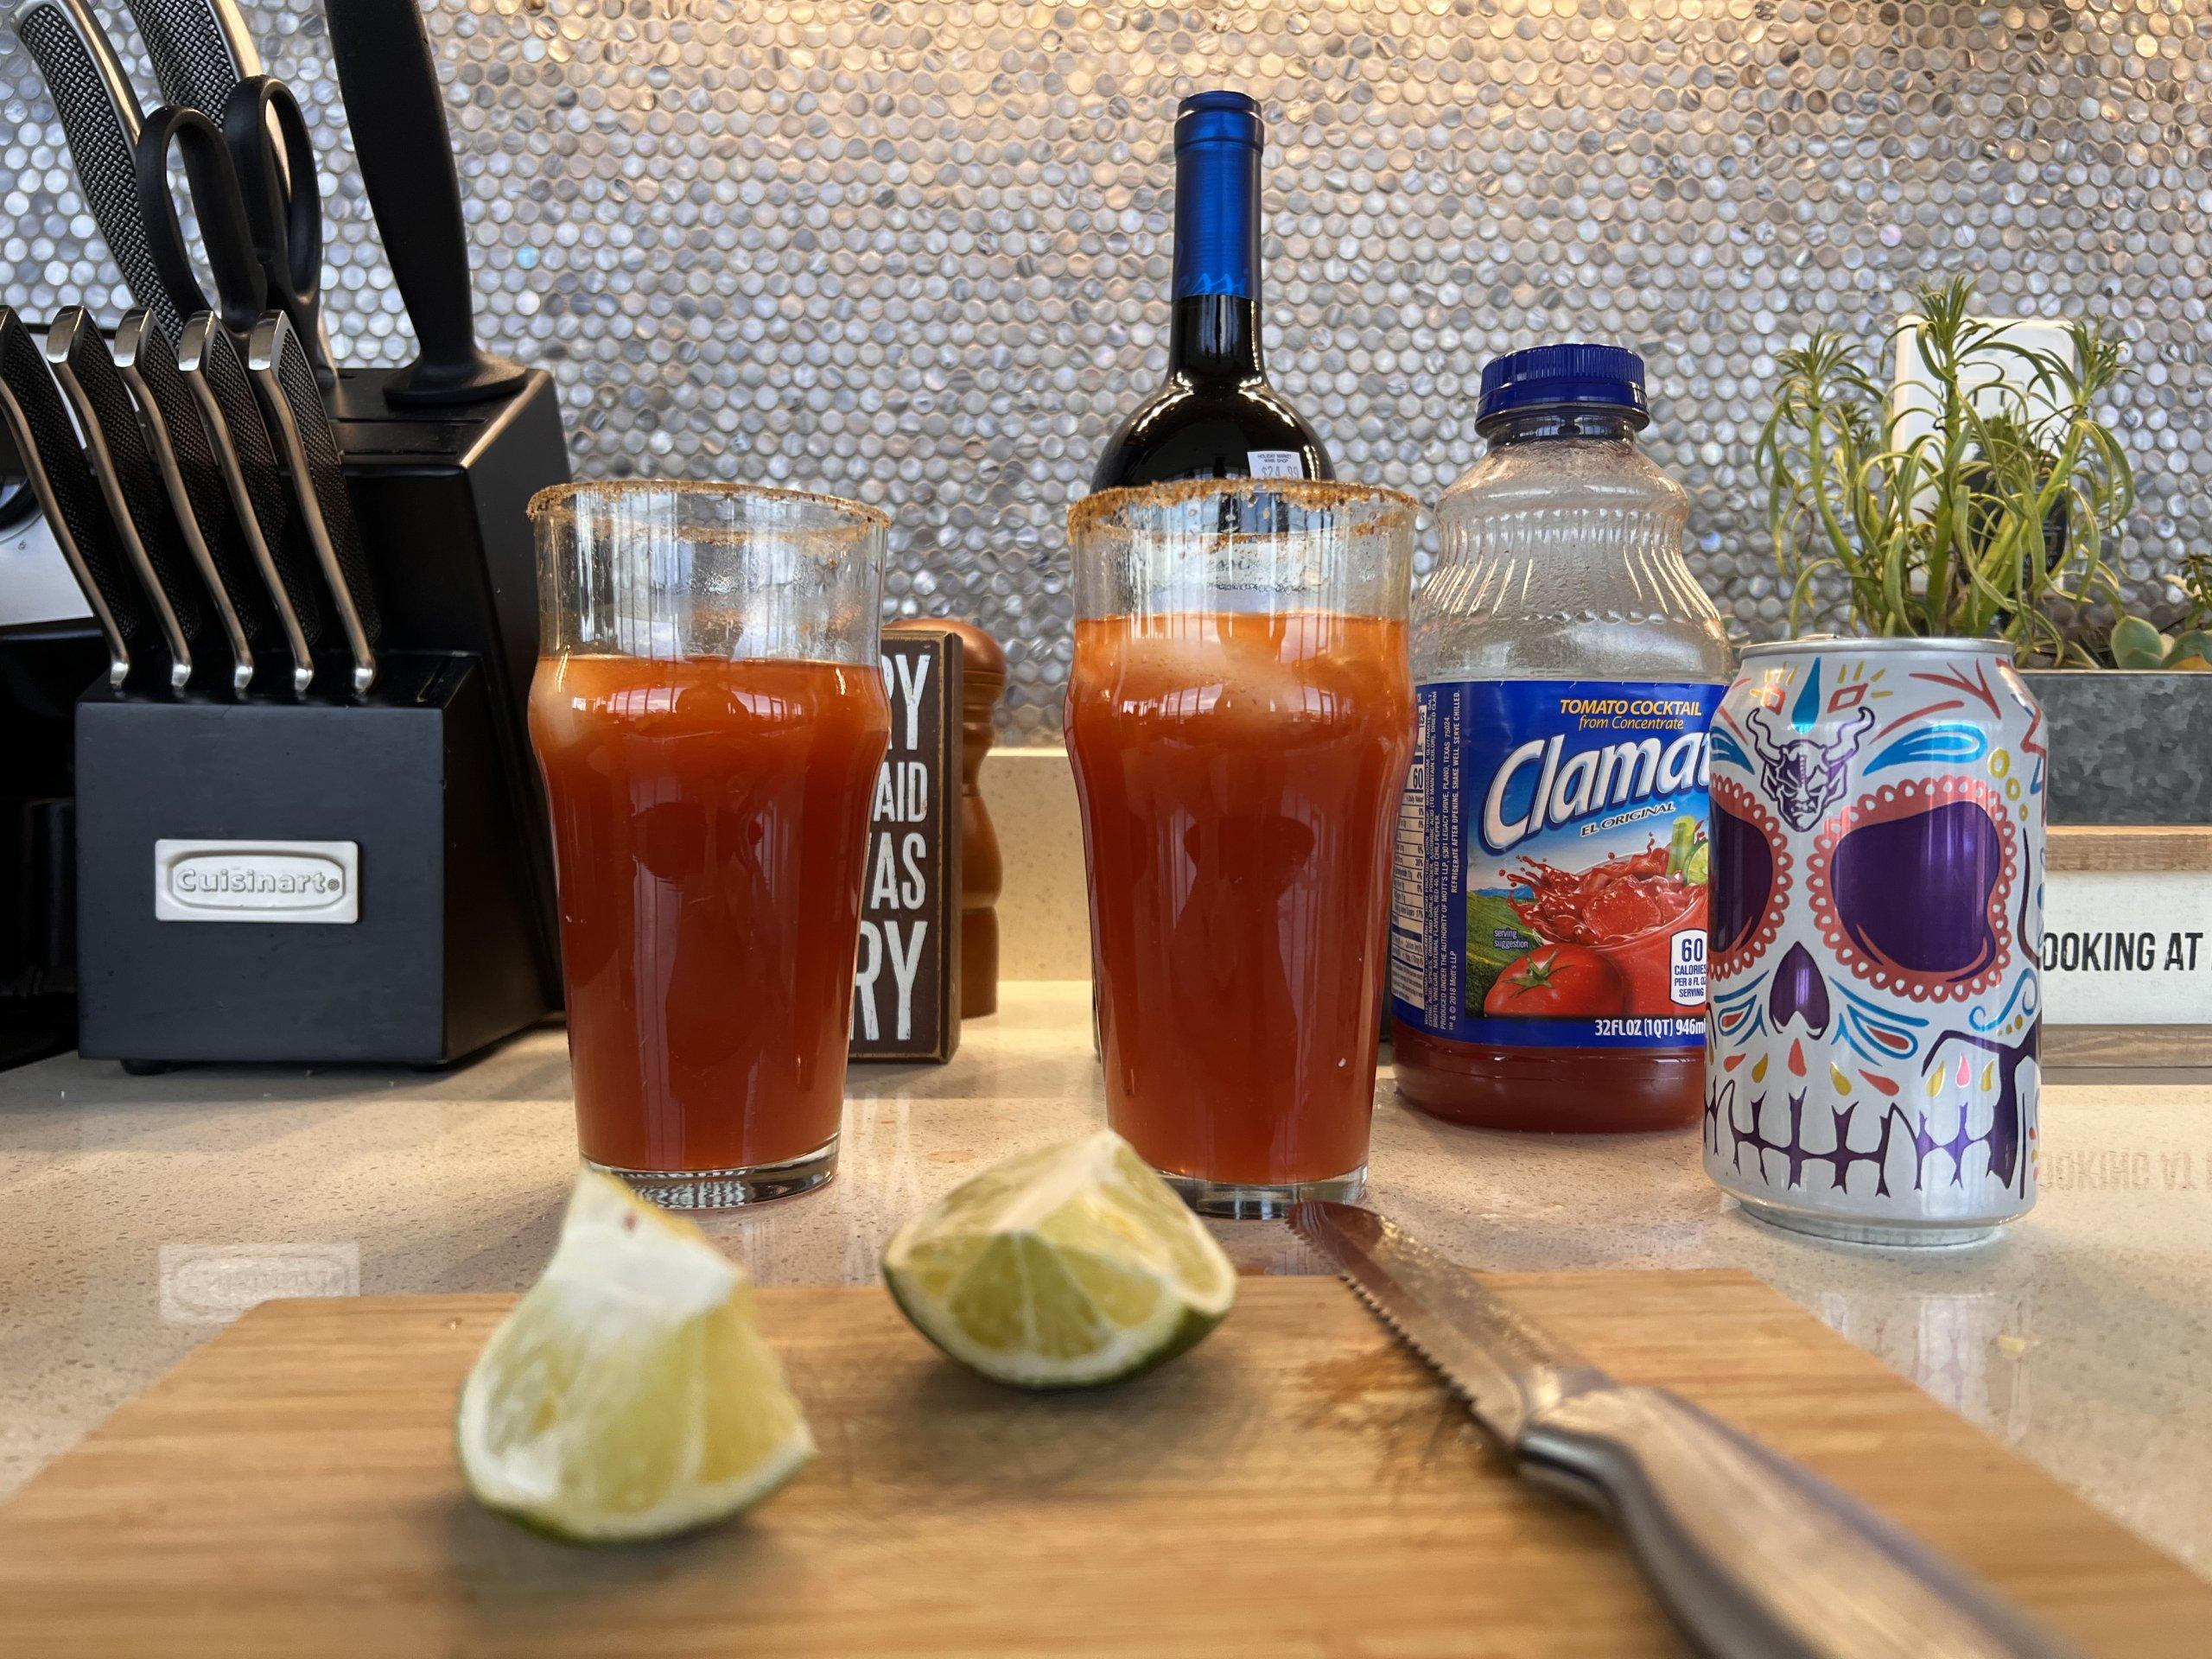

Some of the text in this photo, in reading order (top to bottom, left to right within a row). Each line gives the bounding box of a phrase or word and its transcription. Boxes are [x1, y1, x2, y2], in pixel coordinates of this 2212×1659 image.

[1560, 699, 1702, 716] TOMATO COCKTAIL
[1579, 715, 1684, 731] from Concentrate
[1580, 802, 1676, 837] EL ORIGINAL
[866, 832, 927, 910] AS
[176, 868, 326, 893] Cuisinart
[1441, 904, 1447, 912] OF
[1494, 929, 1518, 940] serving
[1494, 938, 1529, 950] suggestion
[1681, 938, 1703, 963] 60
[2164, 931, 2203, 971] AT
[1675, 978, 1687, 987] PER
[1679, 988, 1704, 997] SERVING
[1644, 1018, 1673, 1039] (1QT)
